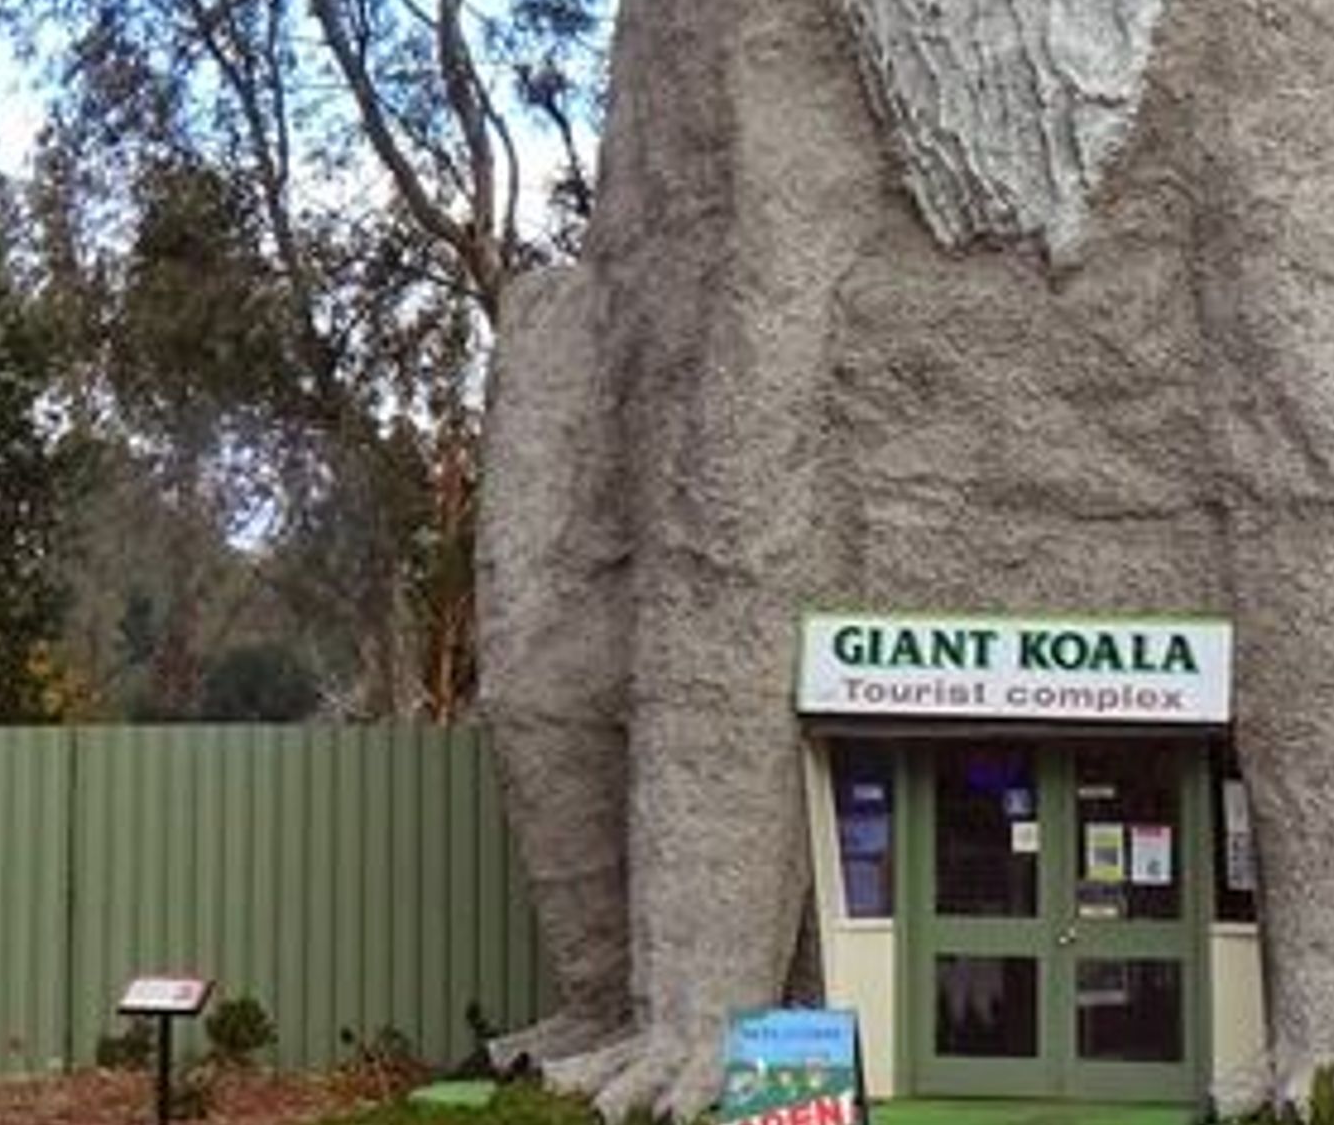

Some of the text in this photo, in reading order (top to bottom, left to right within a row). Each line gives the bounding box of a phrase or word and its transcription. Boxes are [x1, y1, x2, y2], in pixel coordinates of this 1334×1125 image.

[833, 625, 1200, 674] GIANT KOALA
[844, 678, 1184, 713] Tourist complex
